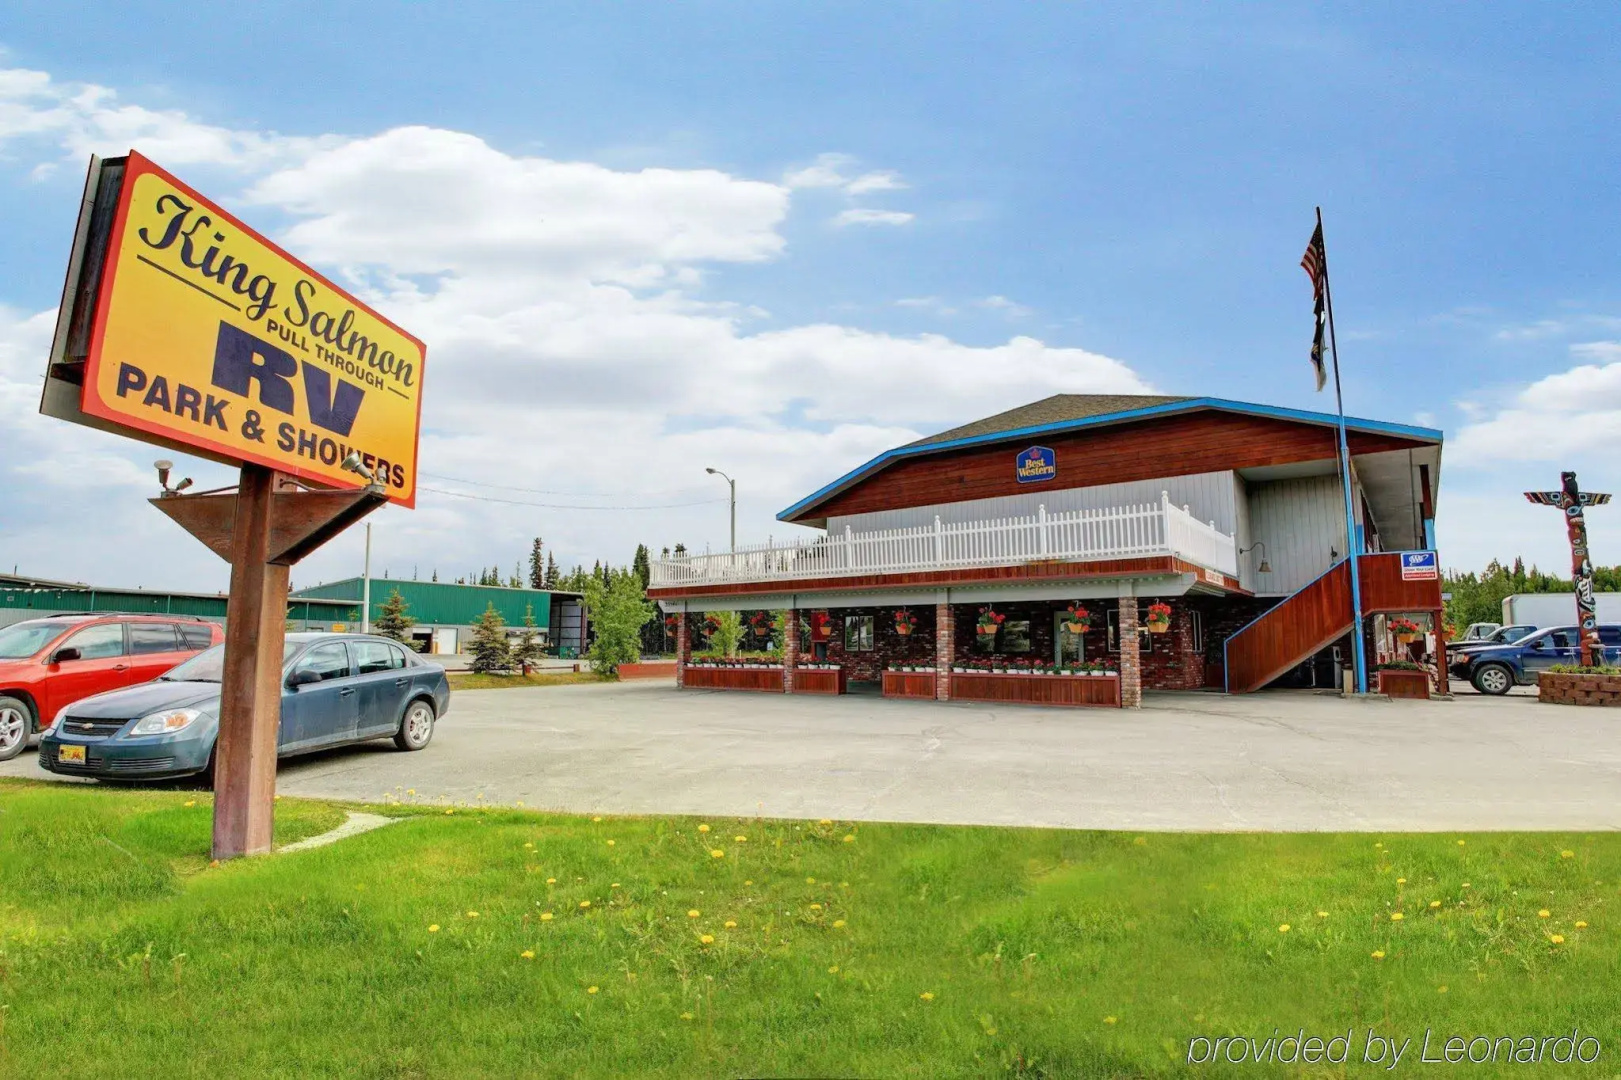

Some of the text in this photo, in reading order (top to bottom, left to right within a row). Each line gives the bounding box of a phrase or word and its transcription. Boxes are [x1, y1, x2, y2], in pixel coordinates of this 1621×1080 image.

[138, 194, 414, 387] King Salmon
[211, 319, 366, 438] RV
[266, 318, 384, 391] PULL THROUGH
[116, 361, 231, 432] PARK
[241, 409, 266, 444] &
[1018, 466, 1054, 477] Western
[1025, 457, 1045, 469] Best
